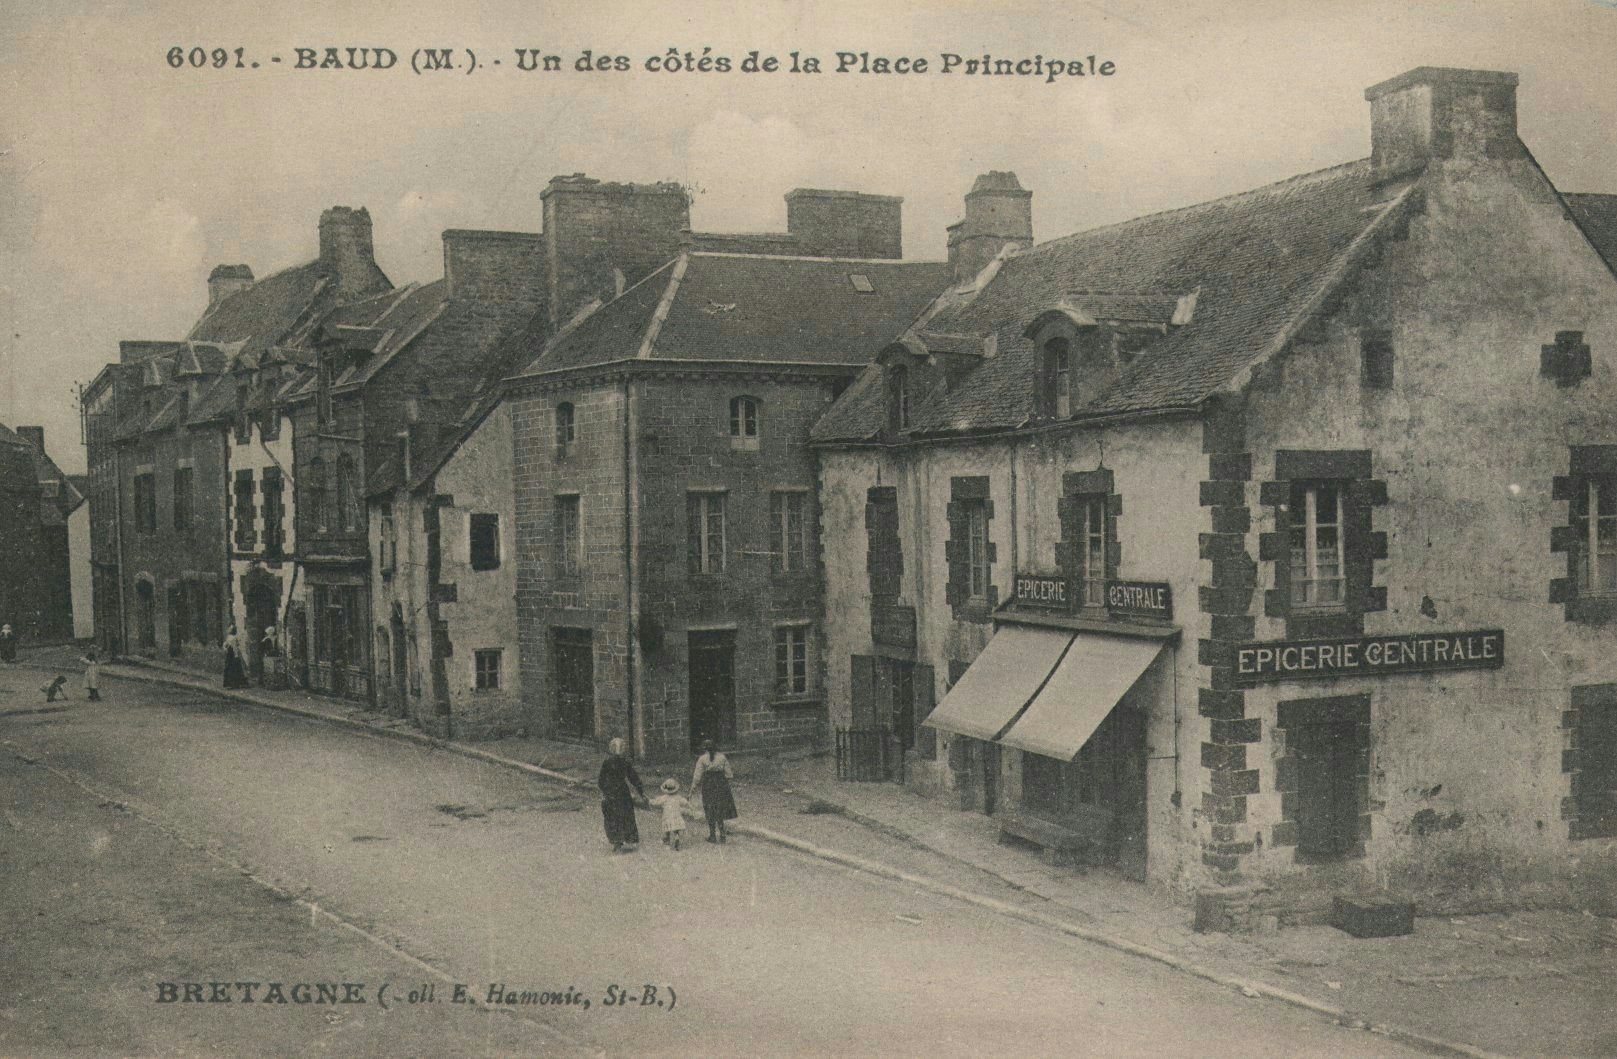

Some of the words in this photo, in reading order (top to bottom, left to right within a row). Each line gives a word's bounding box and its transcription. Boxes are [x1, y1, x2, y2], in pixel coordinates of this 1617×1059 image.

[1017, 579, 1066, 601] EPICERIE
[1109, 585, 1165, 610] CENTRALE
[1238, 643, 1359, 674] EPICERIE
[1365, 635, 1497, 666] CENTRALE
